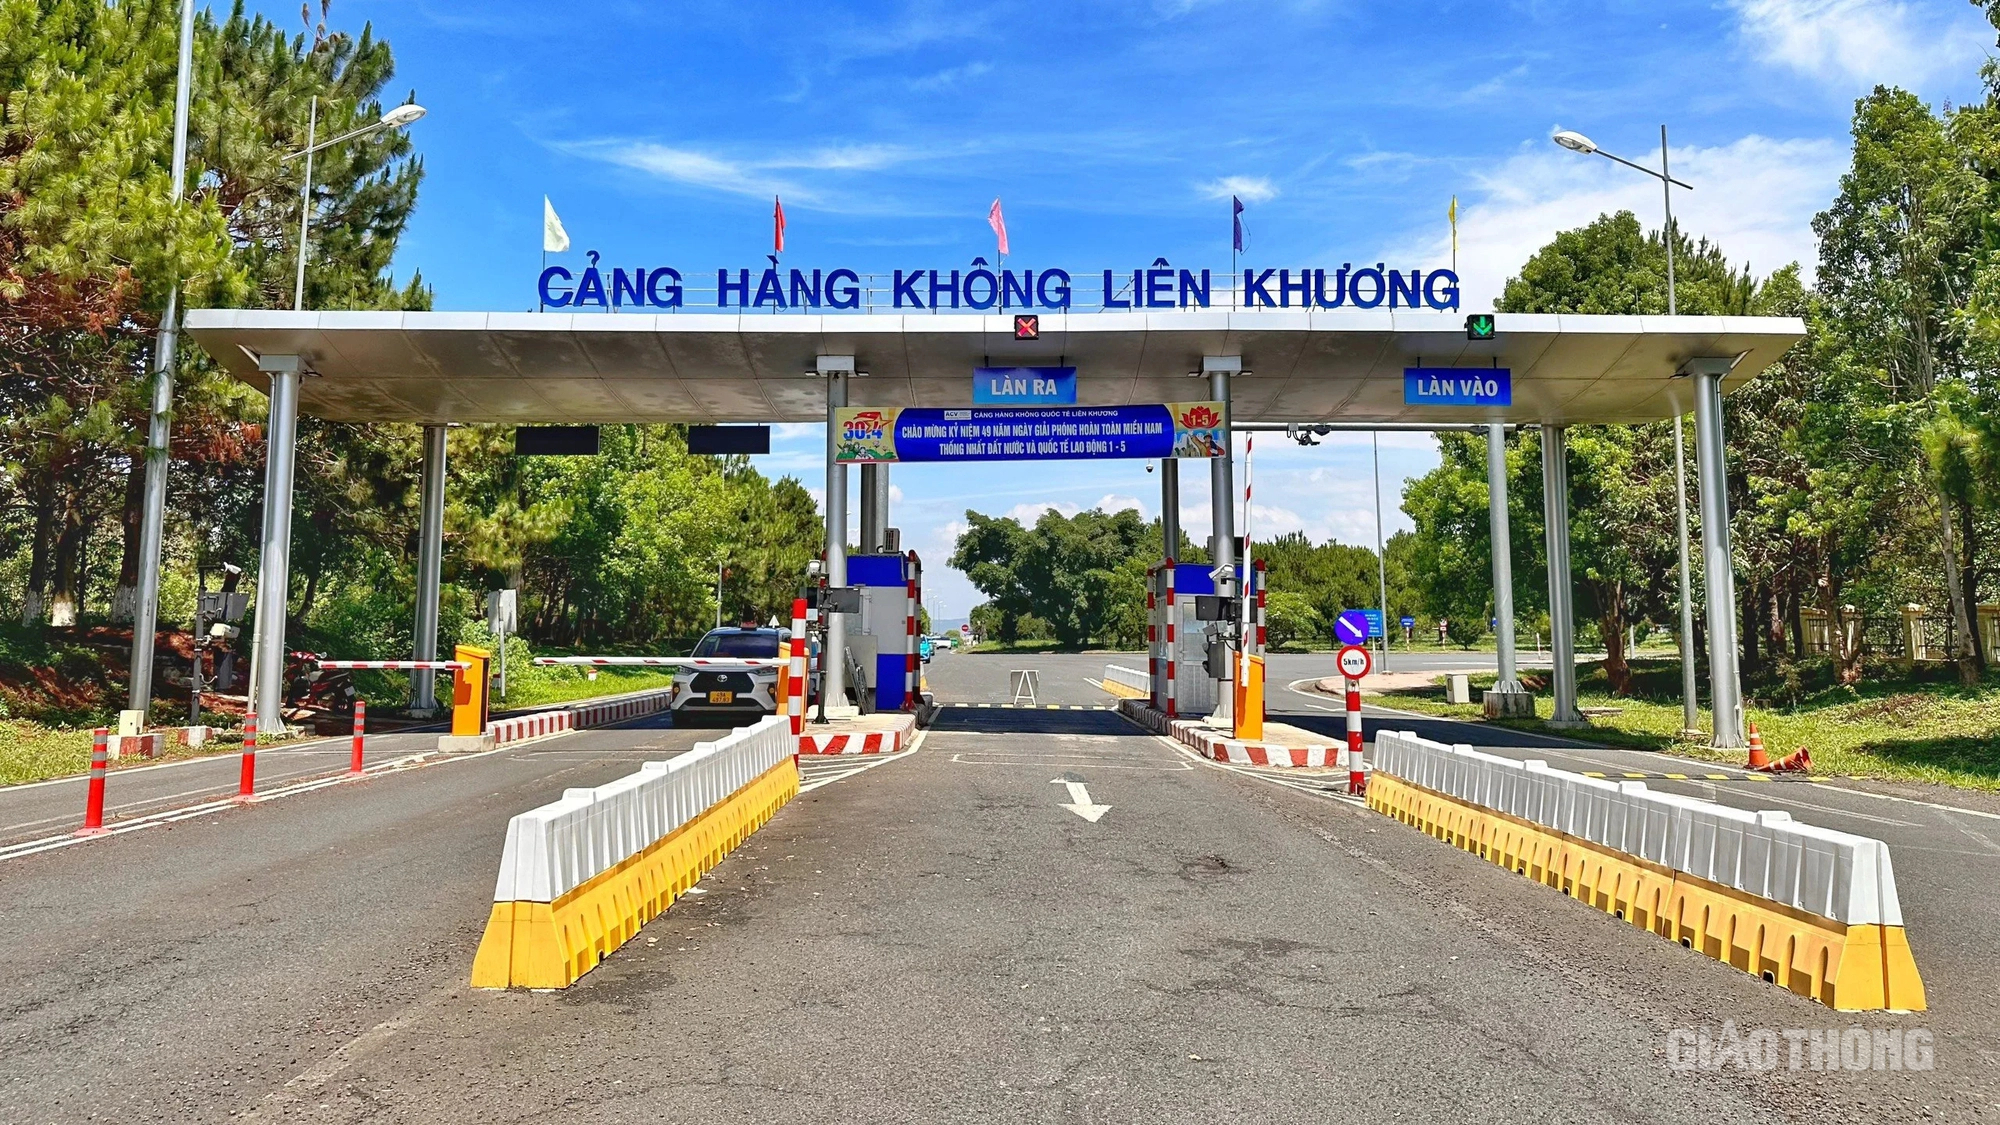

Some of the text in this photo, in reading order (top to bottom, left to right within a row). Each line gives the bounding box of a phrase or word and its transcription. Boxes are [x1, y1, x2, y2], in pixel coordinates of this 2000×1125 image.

[538, 250, 1460, 310] CẢNG HÀNG KHÔNG LIÊN KHƯƠNG
[990, 373, 1059, 397] LÀN RA
[1416, 373, 1499, 397] LÀN VÀO
[1015, 410, 1039, 418] KHÔNG
[1190, 414, 1209, 426] 1-5
[843, 420, 883, 440] 30.4
[901, 423, 922, 438] CHÀO
[924, 423, 947, 438] MỪNG
[948, 422, 958, 438] KỶ
[960, 423, 980, 440] NIỆM
[993, 423, 1011, 437] NĂM
[1012, 422, 1033, 437] NGÀY
[1034, 421, 1050, 436] GIẢI
[1051, 422, 1077, 436] PHÓNG
[1079, 421, 1100, 436] HOÀN
[1101, 421, 1121, 435] TOÀN
[1144, 422, 1163, 435] NAM
[939, 439, 965, 455] THỐNG
[966, 439, 985, 455] NHẤT
[987, 438, 1002, 455] ĐẤT
[1003, 438, 1025, 454] NƯỚC
[1026, 439, 1036, 454] VÀ
[1037, 438, 1058, 454] QUỐC
[1060, 438, 1069, 453] TẾ
[1070, 441, 1085, 453] LAO
[1086, 439, 1107, 455] ĐỘNG
[1120, 441, 1126, 453] 5
